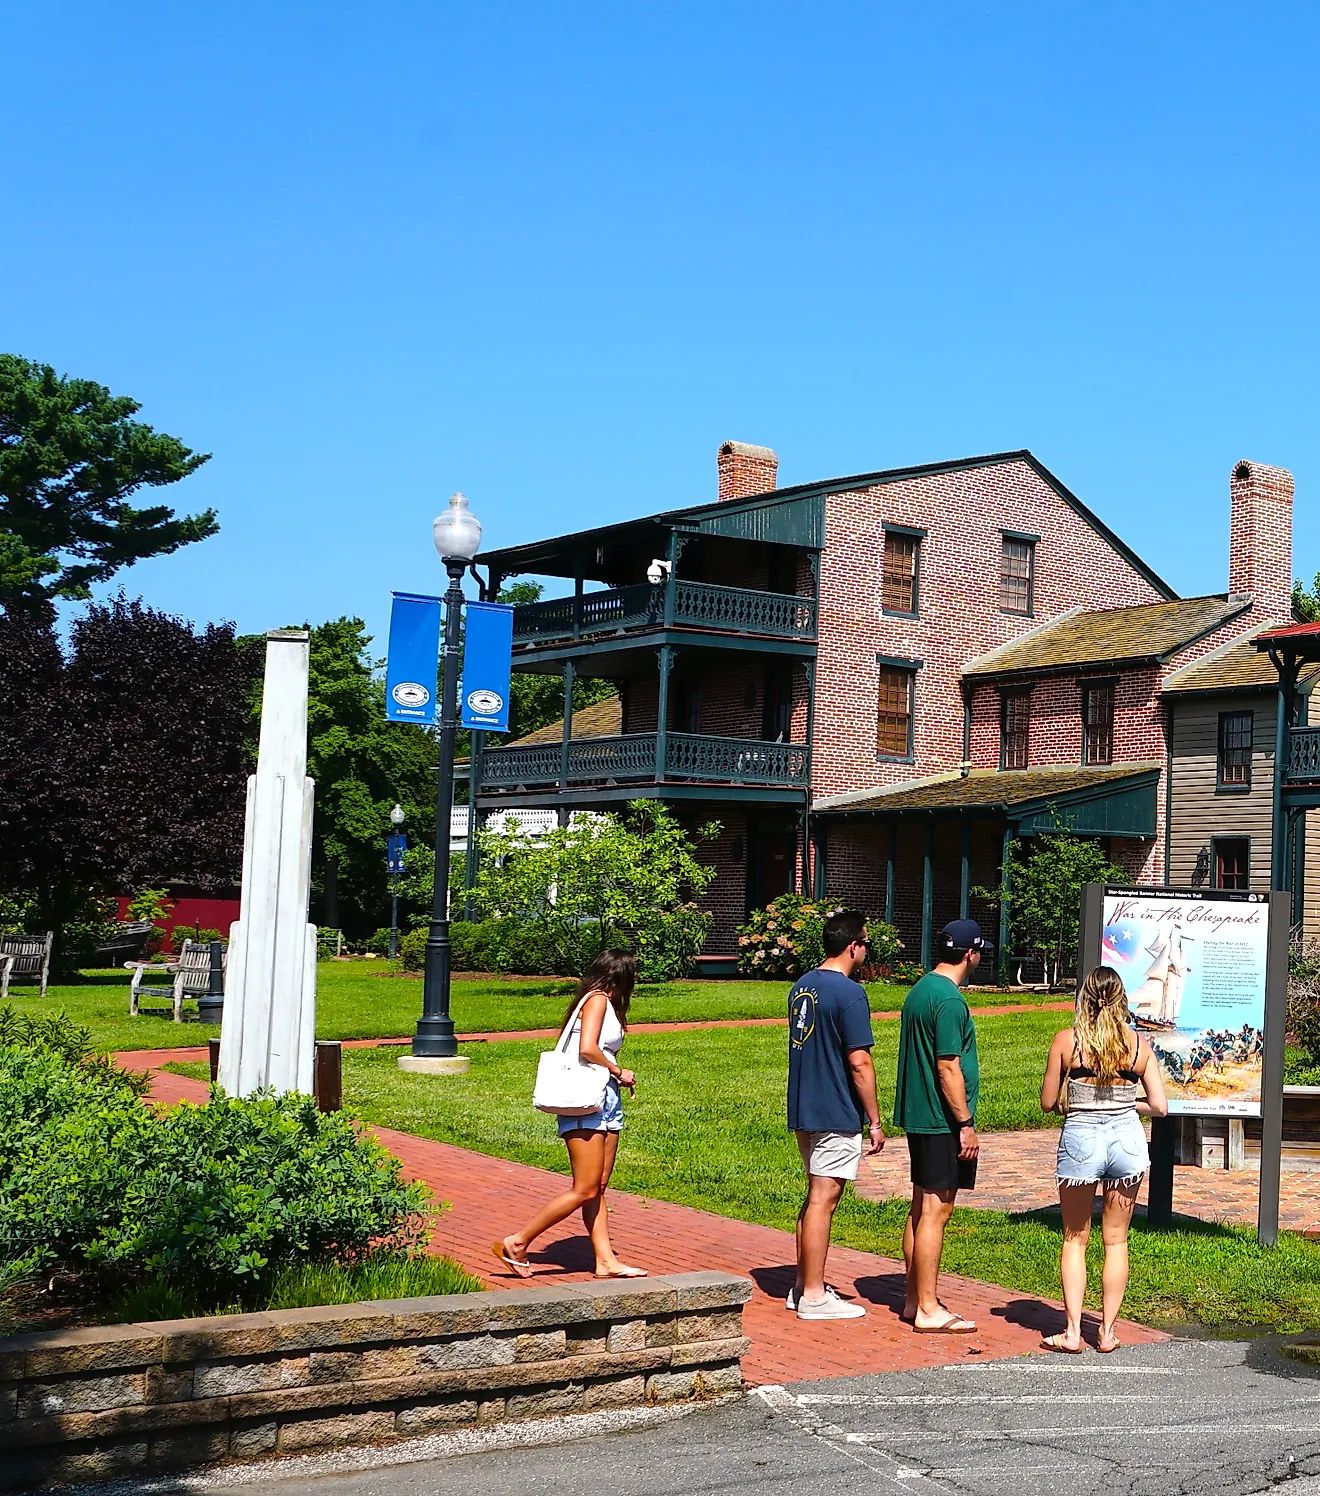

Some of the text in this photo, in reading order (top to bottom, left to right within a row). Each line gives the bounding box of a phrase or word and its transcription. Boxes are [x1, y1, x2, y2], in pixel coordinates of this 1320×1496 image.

[1107, 901, 1260, 933] War in the Chesapeake
